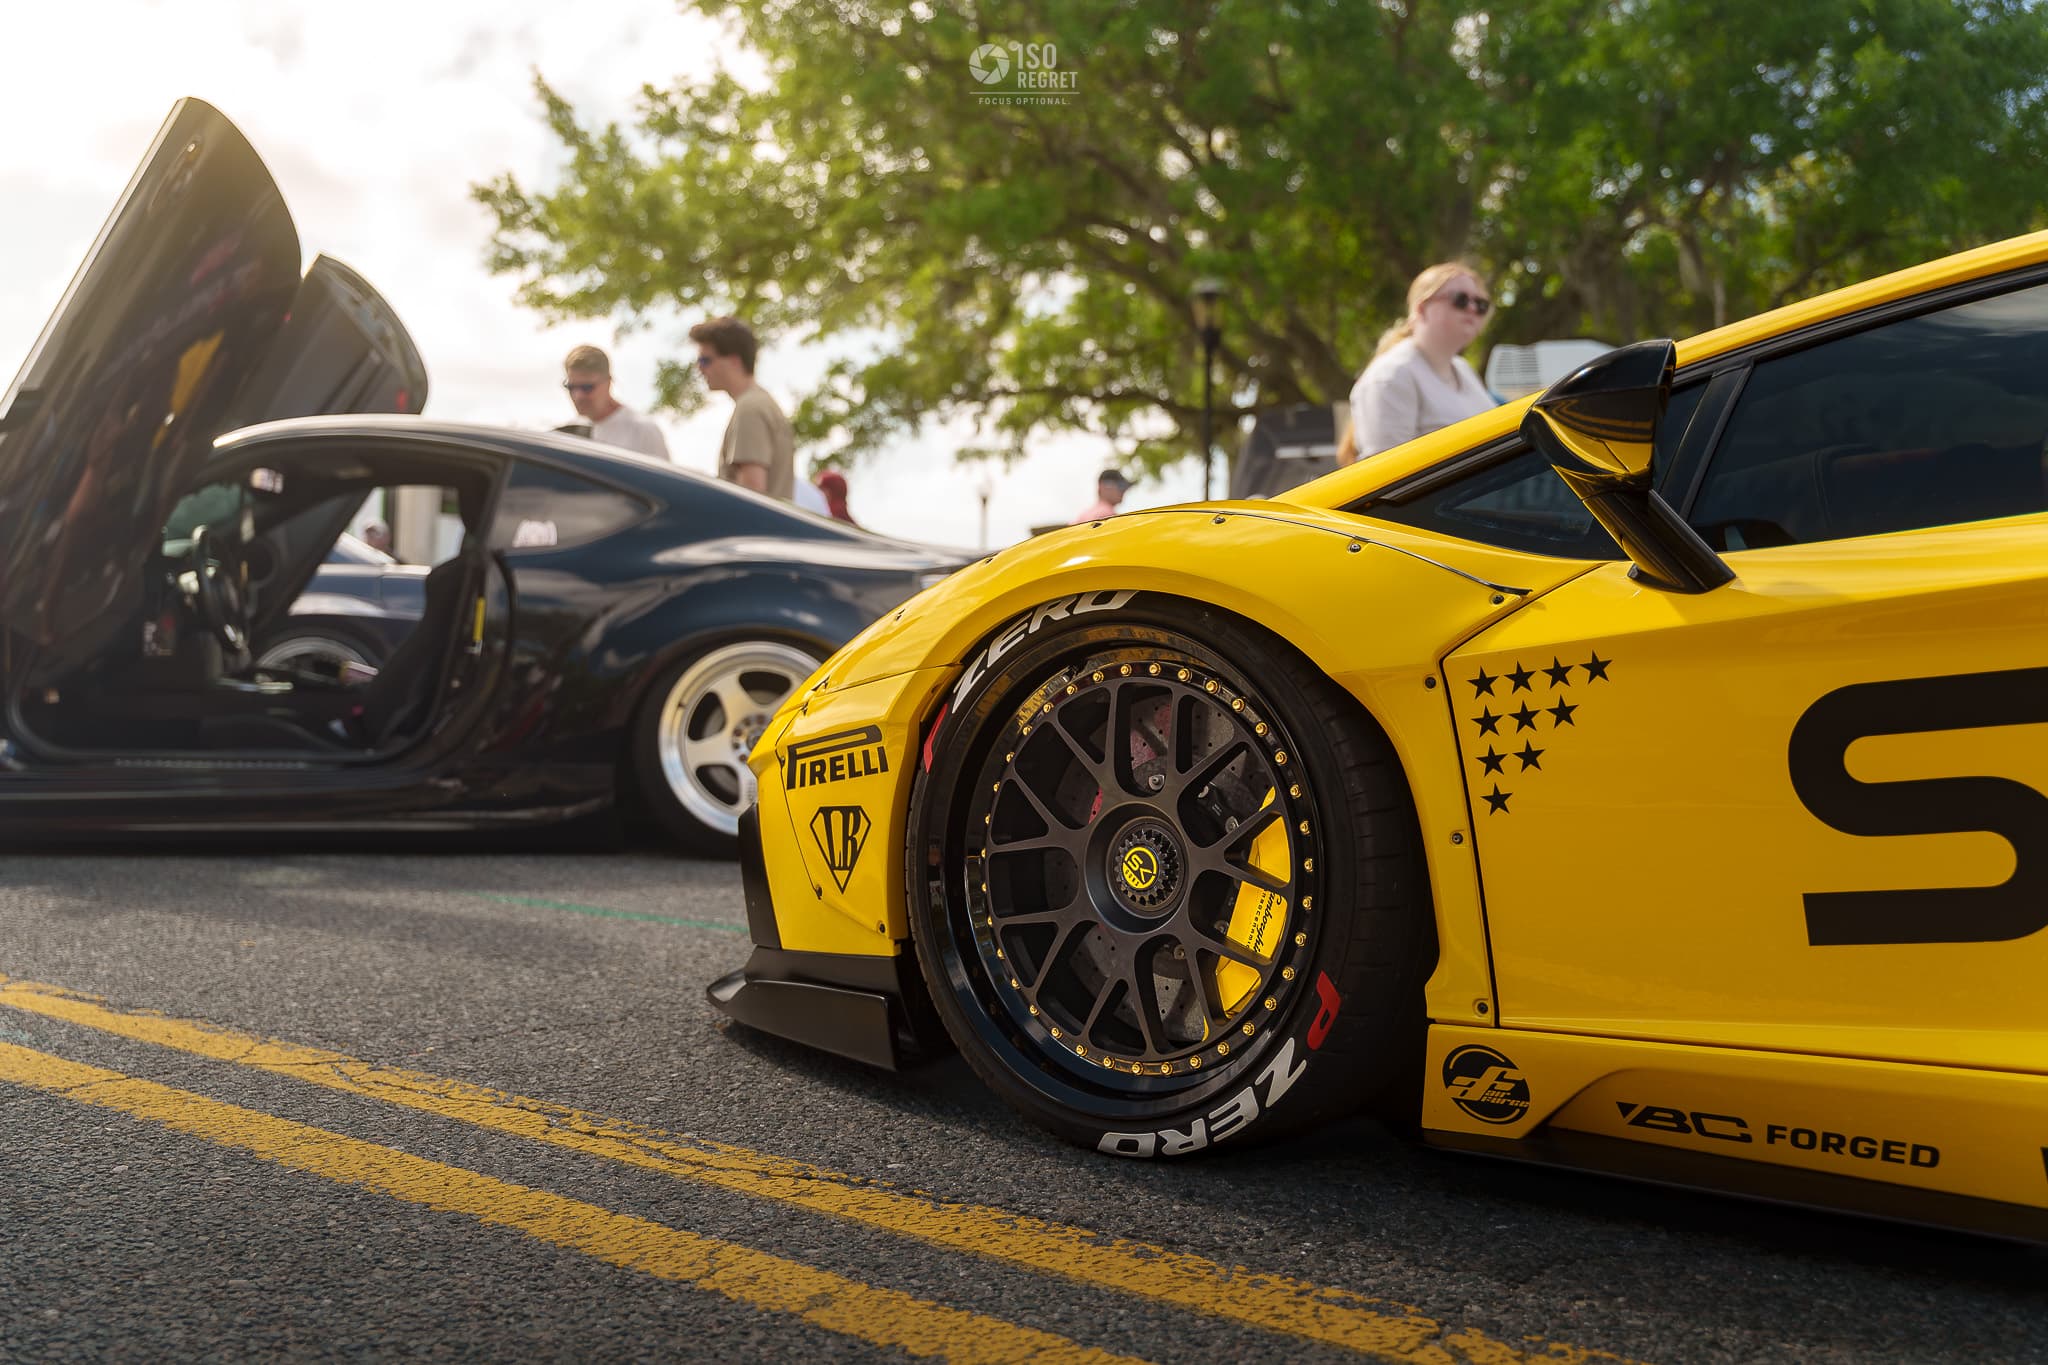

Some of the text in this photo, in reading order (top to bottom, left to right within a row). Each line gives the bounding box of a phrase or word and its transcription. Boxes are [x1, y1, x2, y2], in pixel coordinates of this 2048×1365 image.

[951, 590, 1140, 714] ZERO
[786, 724, 889, 790] PIRELLI
[1096, 970, 1342, 1158] P ZERO
[1766, 1124, 1940, 1168] FORGED
